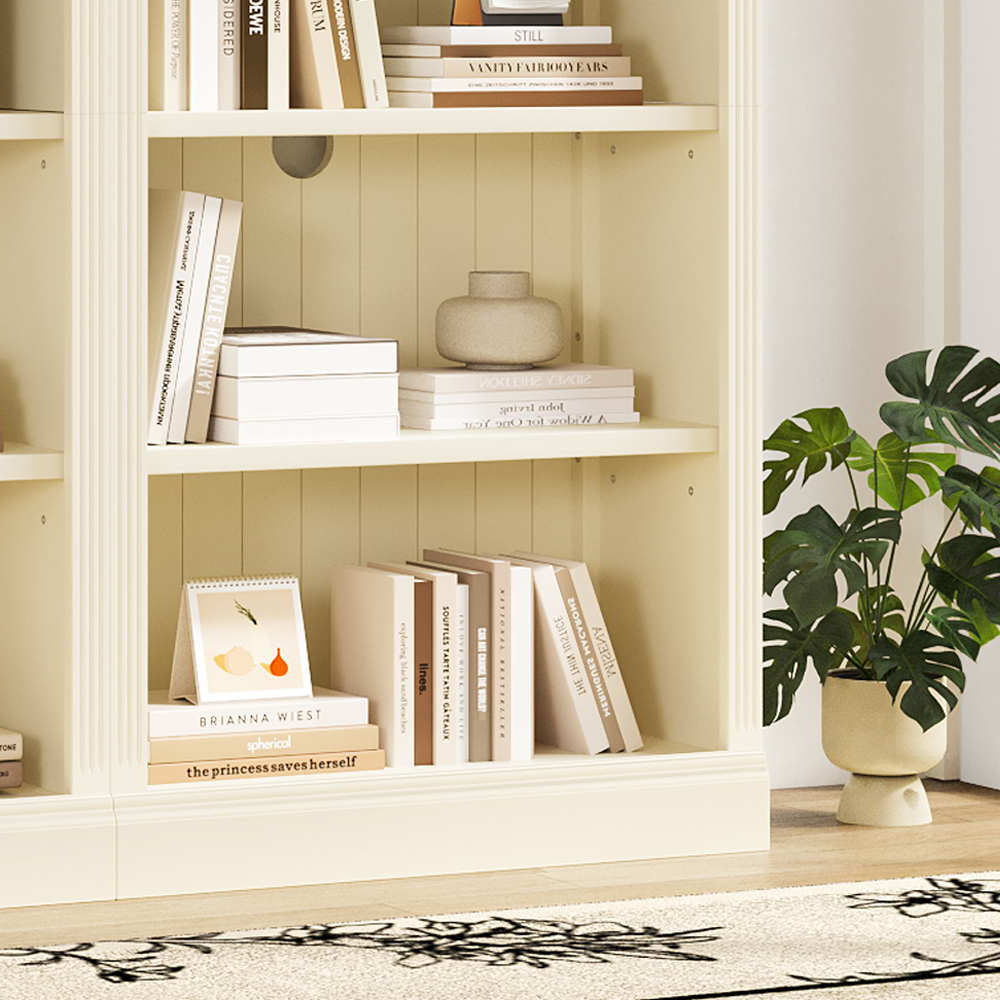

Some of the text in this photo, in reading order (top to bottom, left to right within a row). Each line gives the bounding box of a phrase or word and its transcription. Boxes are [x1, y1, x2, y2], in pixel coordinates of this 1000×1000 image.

[310, 0, 326, 32] RUM
[338, 30, 351, 60] DESIGN
[514, 30, 544, 42] STILL
[468, 62, 514, 72] VANITY
[418, 663, 428, 696] lines.
[200, 709, 322, 728] BRIANNA WIEST
[247, 734, 292, 754] spherical
[186, 756, 358, 780] the princess saves herself
